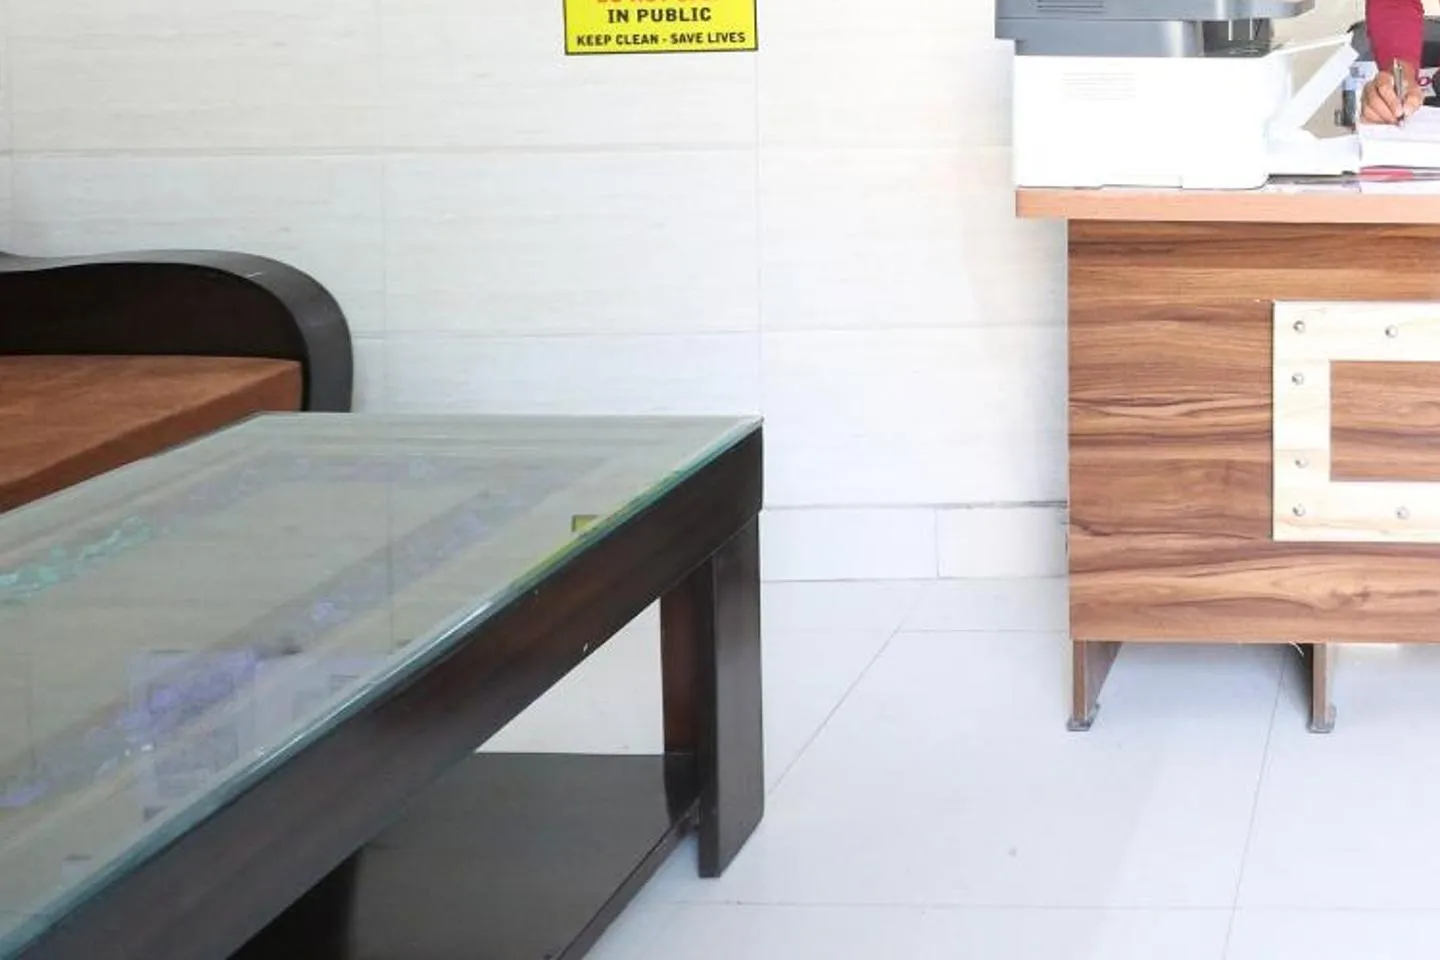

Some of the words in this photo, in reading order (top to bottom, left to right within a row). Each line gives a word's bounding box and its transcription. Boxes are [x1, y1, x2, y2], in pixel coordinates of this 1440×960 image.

[608, 8, 629, 23] IN
[637, 7, 712, 22] PUBLIC
[576, 34, 612, 47] KEEP
[615, 33, 658, 46] CLEAN
[670, 32, 703, 45] SAVE
[707, 31, 746, 44] LIVES
